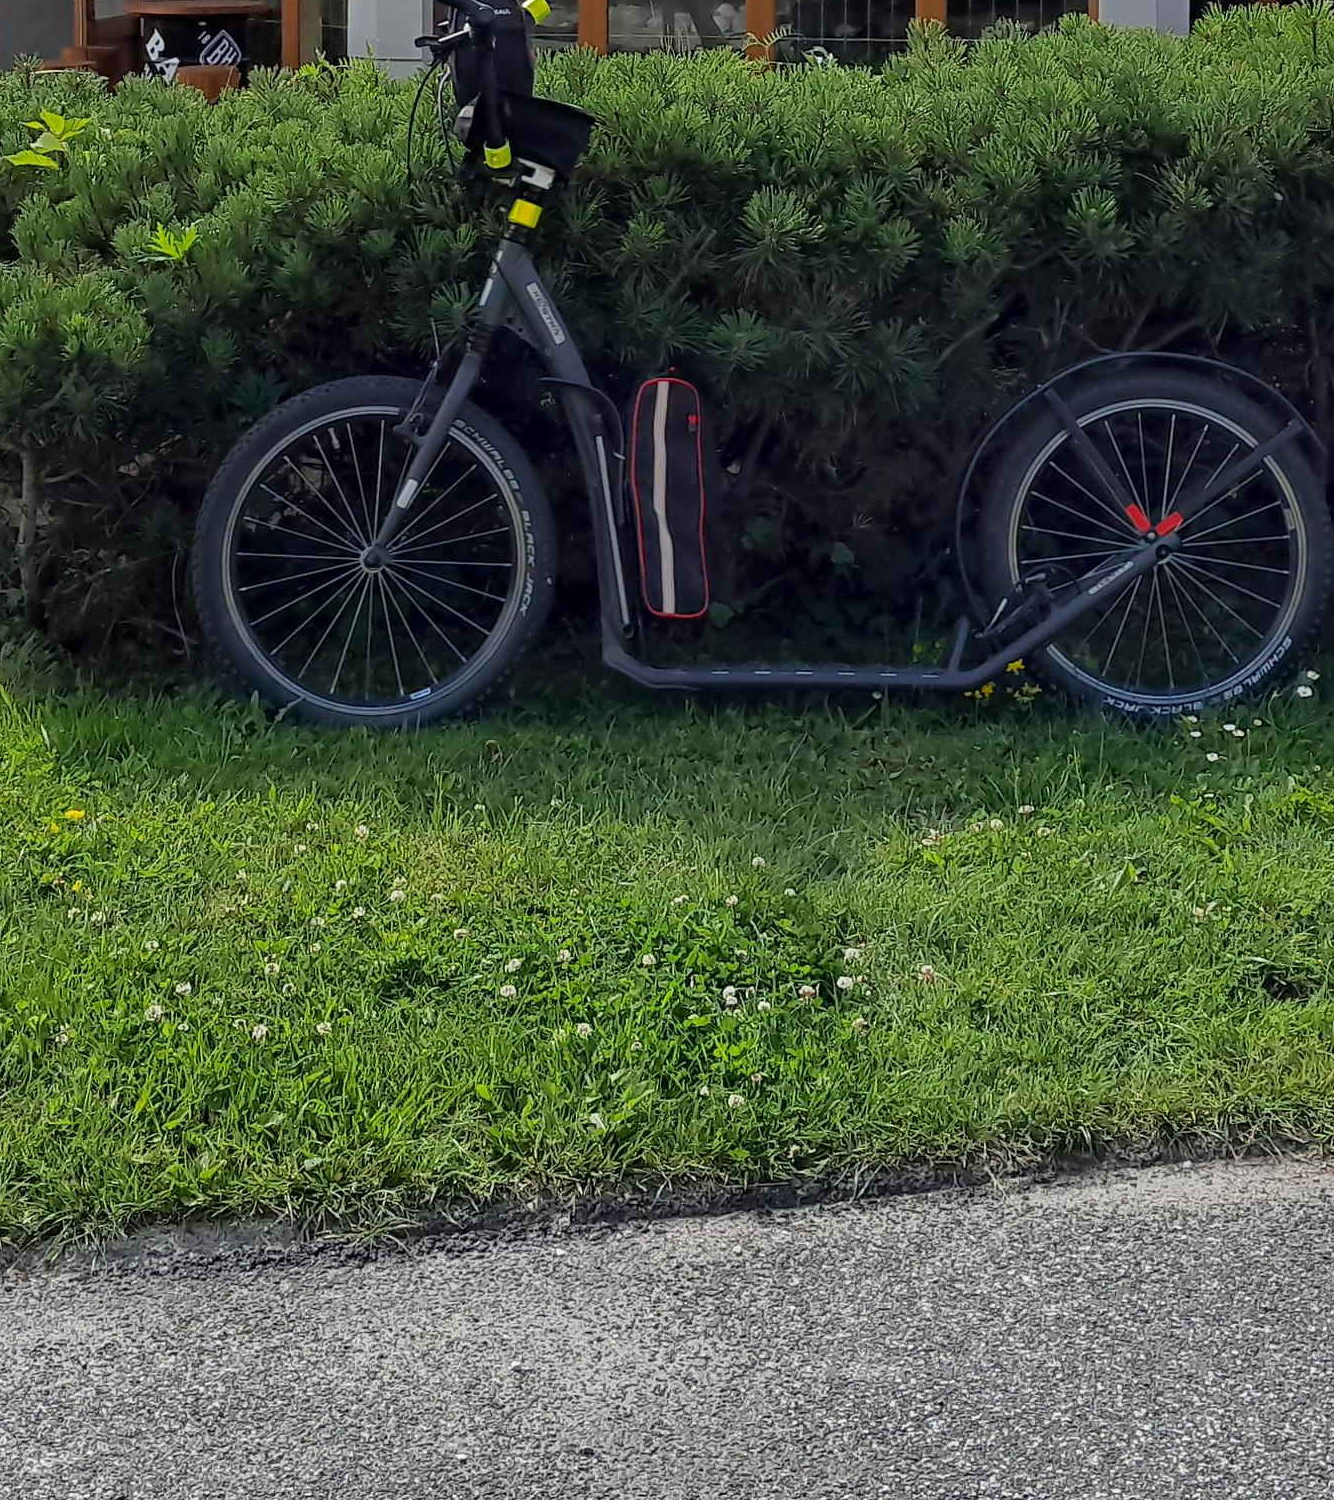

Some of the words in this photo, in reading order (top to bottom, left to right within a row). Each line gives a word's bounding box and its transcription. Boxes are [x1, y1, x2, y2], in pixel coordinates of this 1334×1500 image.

[453, 418, 520, 491] SCHWALBE
[520, 509, 535, 568] BLACK
[518, 573, 535, 618] JACK
[1223, 635, 1293, 701] SCHWALBE
[1101, 695, 1141, 713] JACK
[1149, 700, 1204, 716] BLACK
